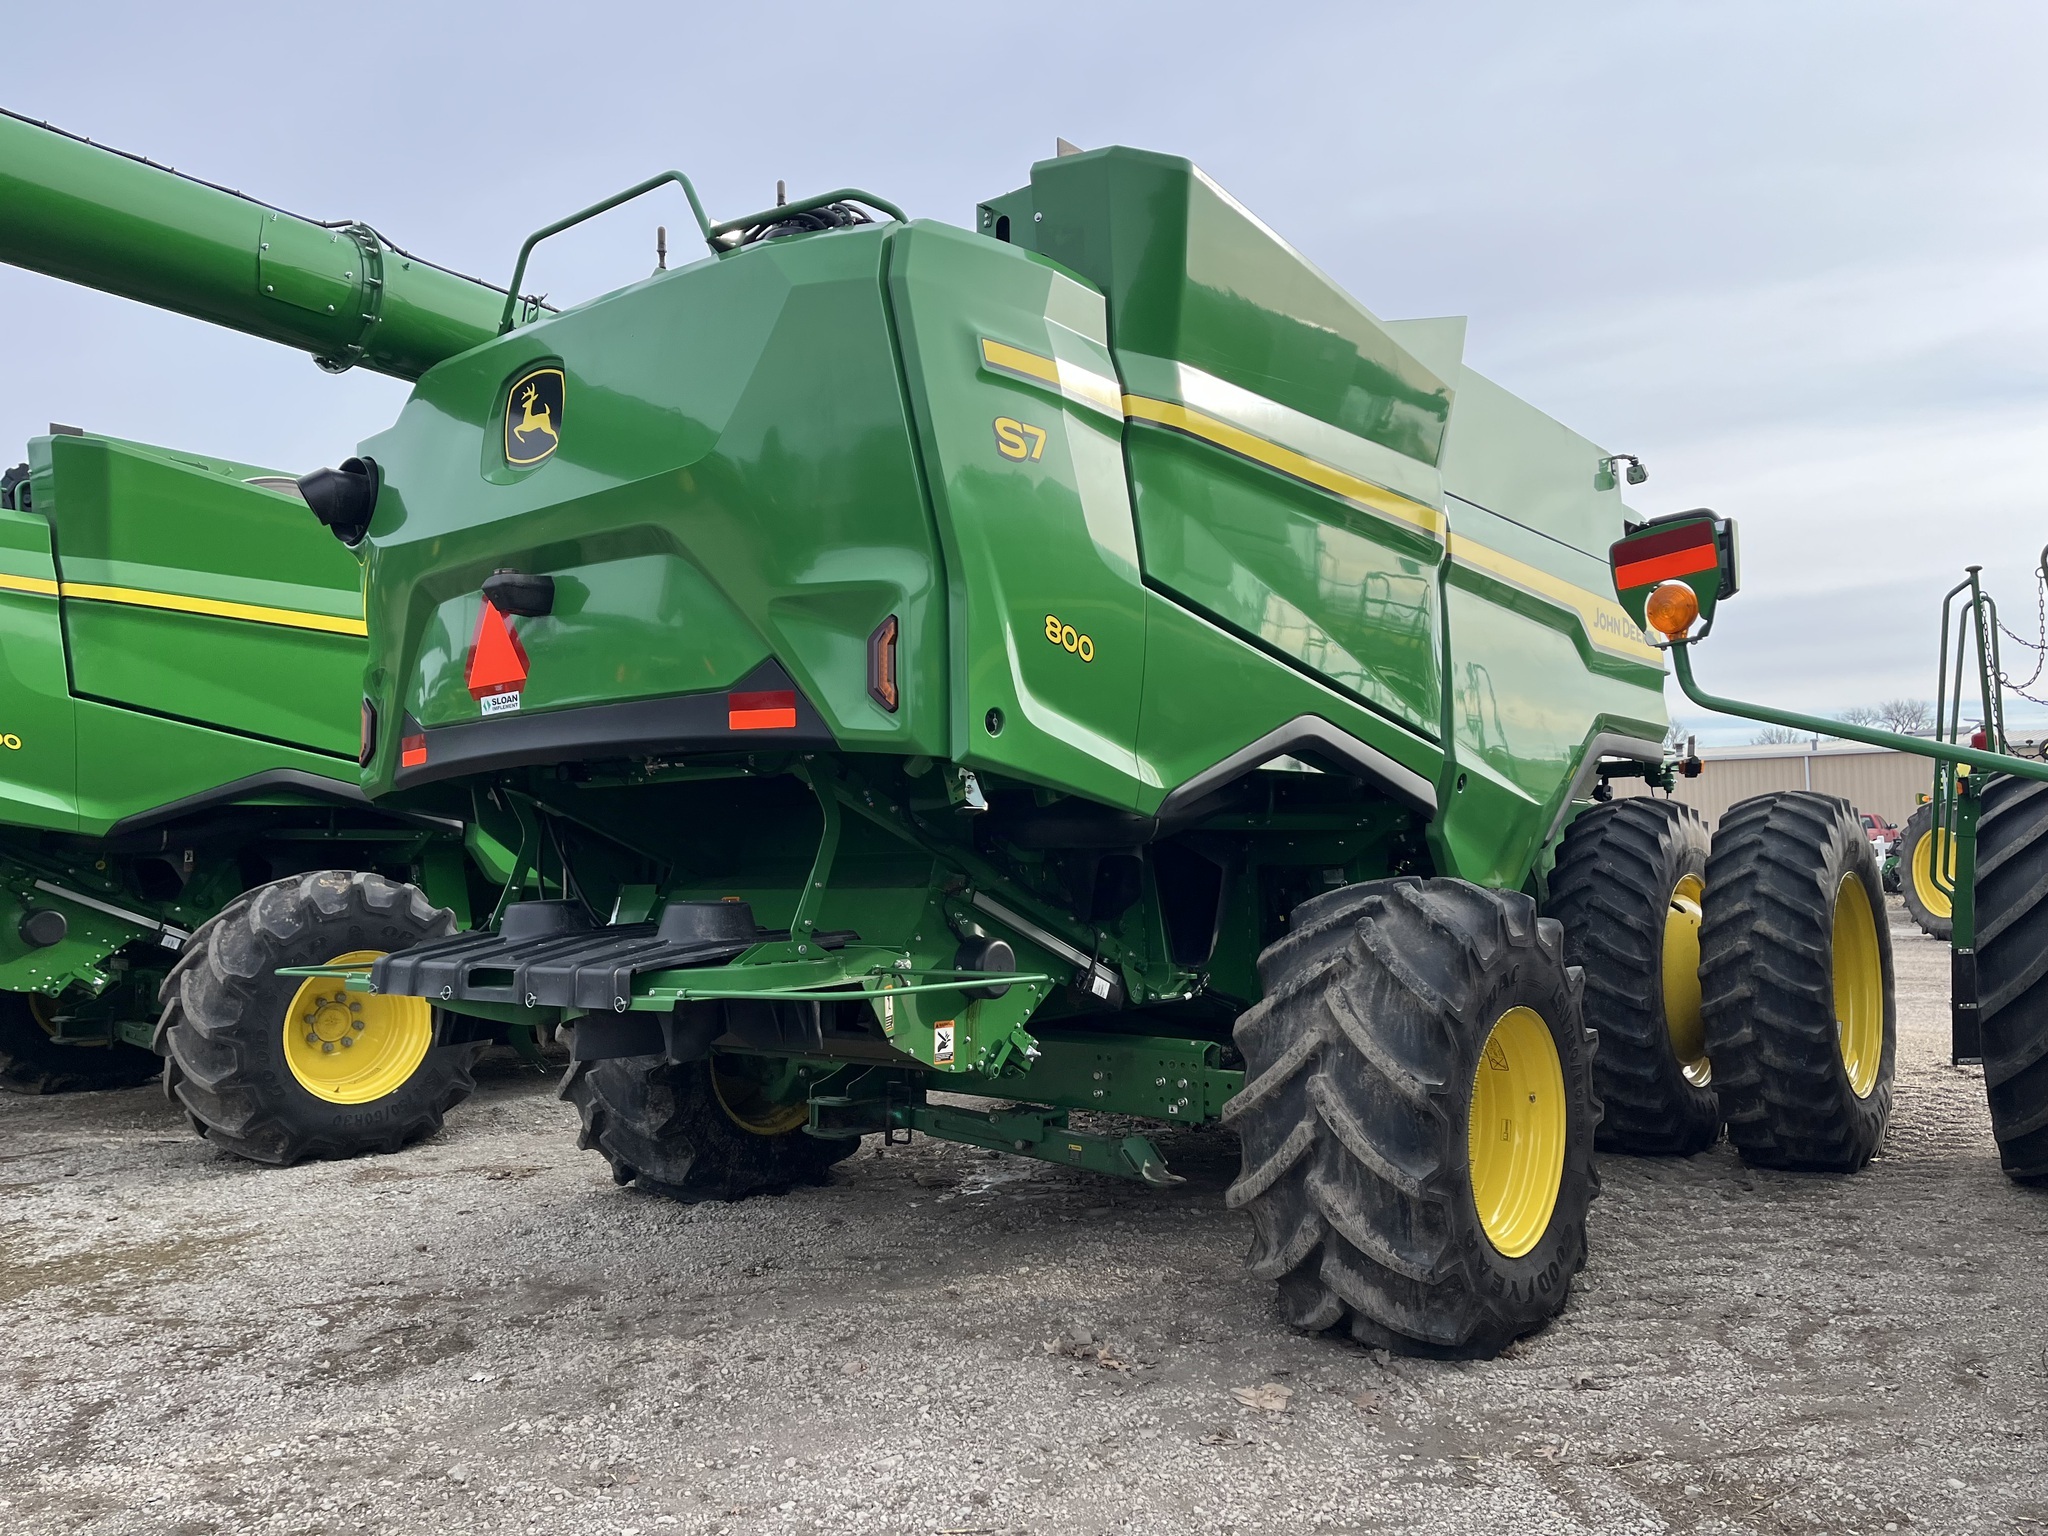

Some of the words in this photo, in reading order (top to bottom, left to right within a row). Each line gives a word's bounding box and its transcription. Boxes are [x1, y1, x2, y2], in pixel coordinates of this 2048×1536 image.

[992, 416, 1047, 463] S7
[1045, 614, 1095, 663] 800
[1594, 607, 1621, 636] JOHN
[1622, 616, 1646, 645] DEE
[491, 694, 518, 706] SLOAN
[492, 702, 518, 711] IMPLEMENT
[0, 732, 22, 750] 0
